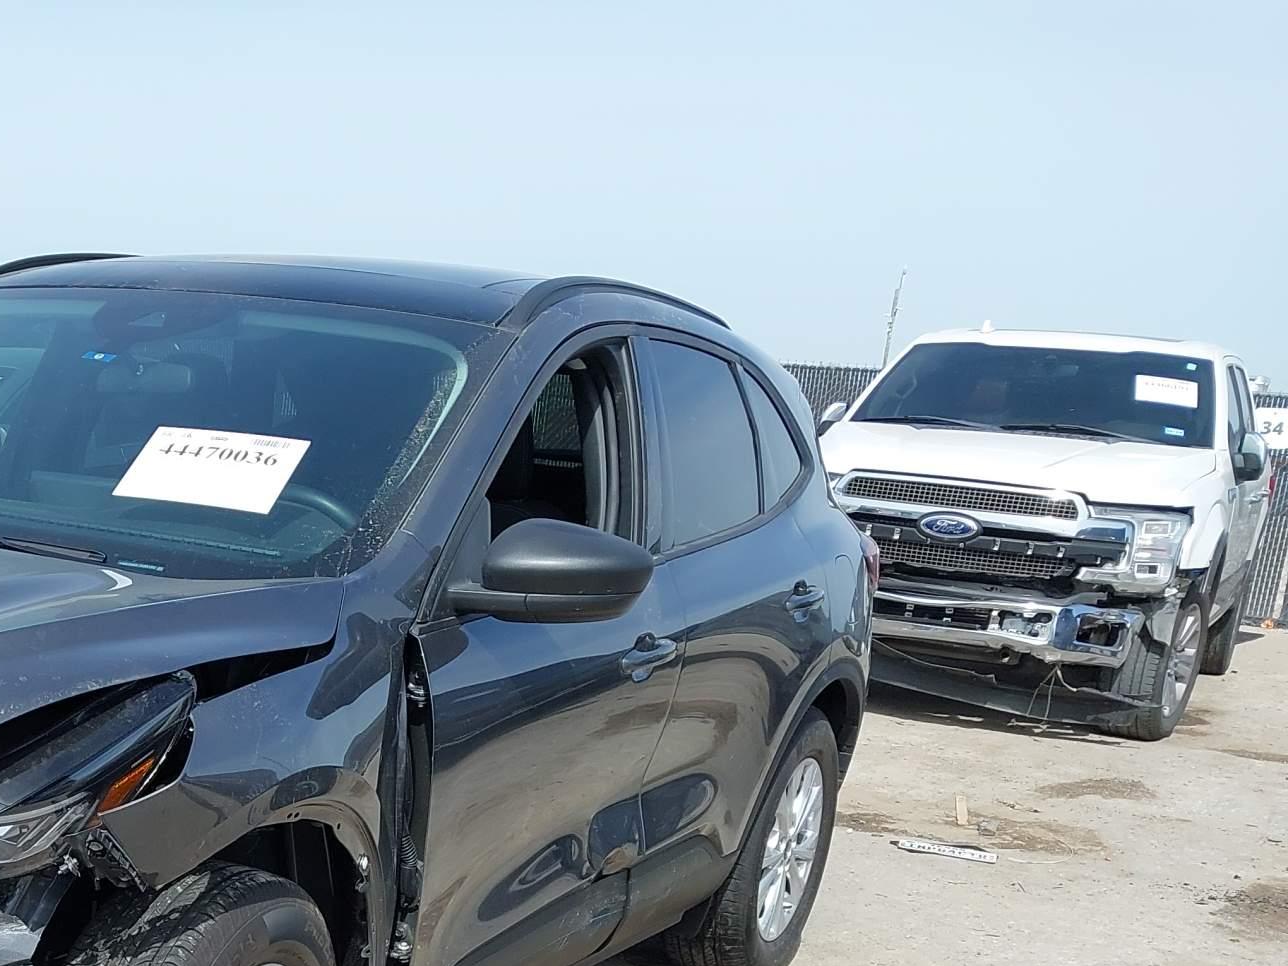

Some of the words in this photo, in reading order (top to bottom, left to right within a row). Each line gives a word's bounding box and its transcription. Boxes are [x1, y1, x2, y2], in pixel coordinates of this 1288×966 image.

[1261, 421, 1285, 436] 34
[159, 442, 282, 467] 44470036
[932, 519, 966, 535] Ford
